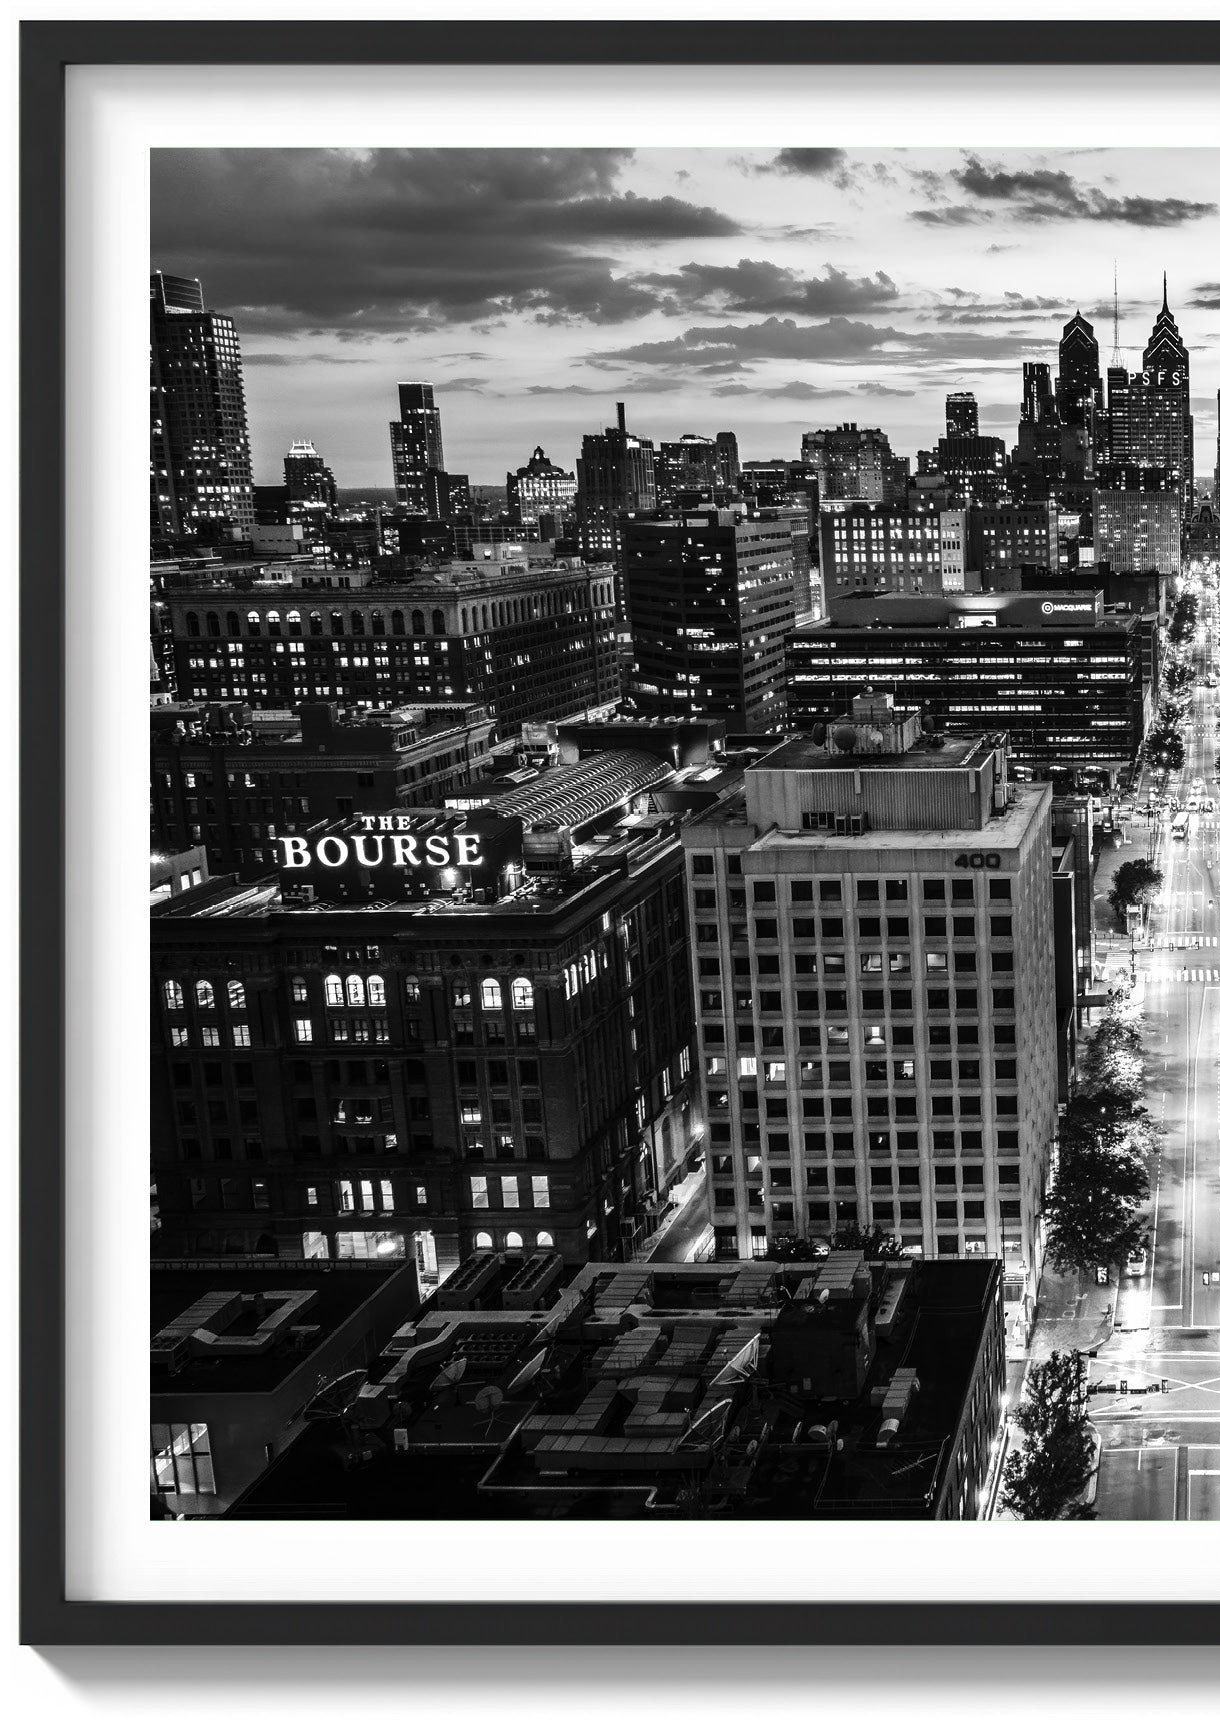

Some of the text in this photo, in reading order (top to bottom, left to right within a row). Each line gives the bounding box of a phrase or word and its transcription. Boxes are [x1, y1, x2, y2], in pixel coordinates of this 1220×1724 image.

[1128, 371, 1180, 386] PSFS
[361, 815, 411, 830] THE
[278, 833, 484, 868] BOURSE
[954, 853, 1001, 869] 400
